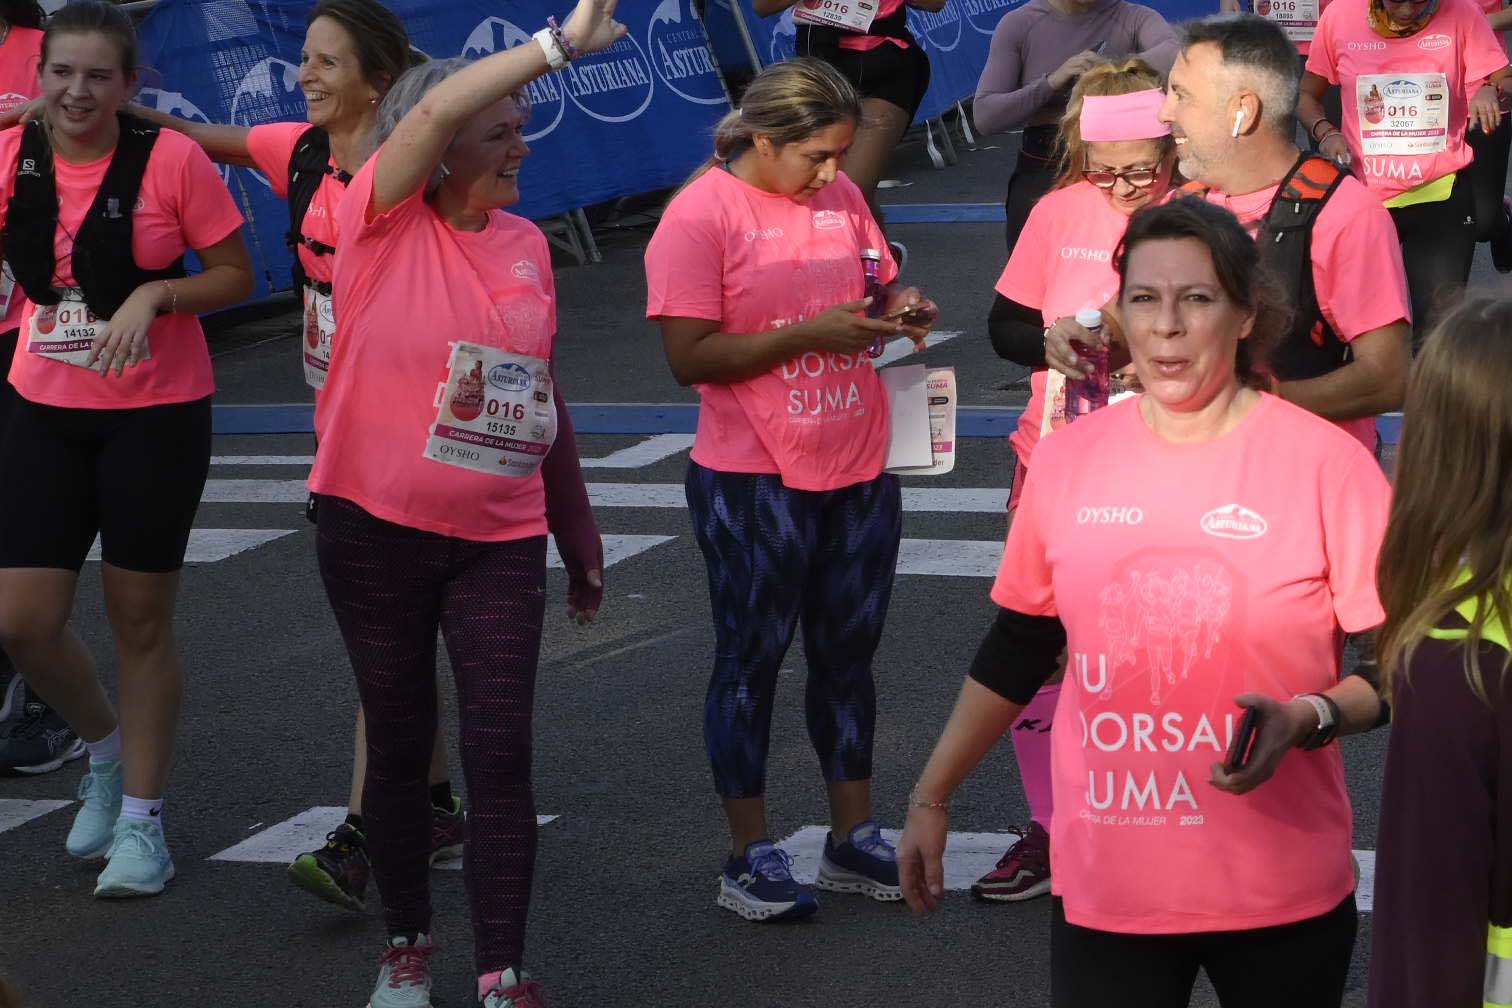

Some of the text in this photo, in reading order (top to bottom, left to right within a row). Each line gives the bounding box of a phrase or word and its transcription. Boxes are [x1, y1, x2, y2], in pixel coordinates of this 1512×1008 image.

[823, 0, 848, 14] 016
[1273, 1, 1296, 11] 016
[1347, 41, 1386, 51] OYSHO
[570, 57, 649, 97] ASTURIANA
[1387, 104, 1418, 117] 016
[1391, 120, 1414, 129] 32067
[1364, 157, 1423, 179] SUMA
[1061, 247, 1110, 262] OYSHO
[64, 328, 96, 338] 14132
[39, 342, 67, 351] CARRERA
[68, 341, 80, 350] DE
[782, 350, 870, 380] DORSA
[787, 382, 861, 415] SUMA
[487, 398, 525, 420] 016
[487, 420, 517, 436] 15135
[449, 430, 484, 443] CARRERA
[485, 436, 496, 445] DE
[495, 439, 505, 447] LA
[439, 444, 480, 460] OYSHO
[1077, 507, 1143, 525] OYSHO
[1086, 770, 1198, 810] UMA
